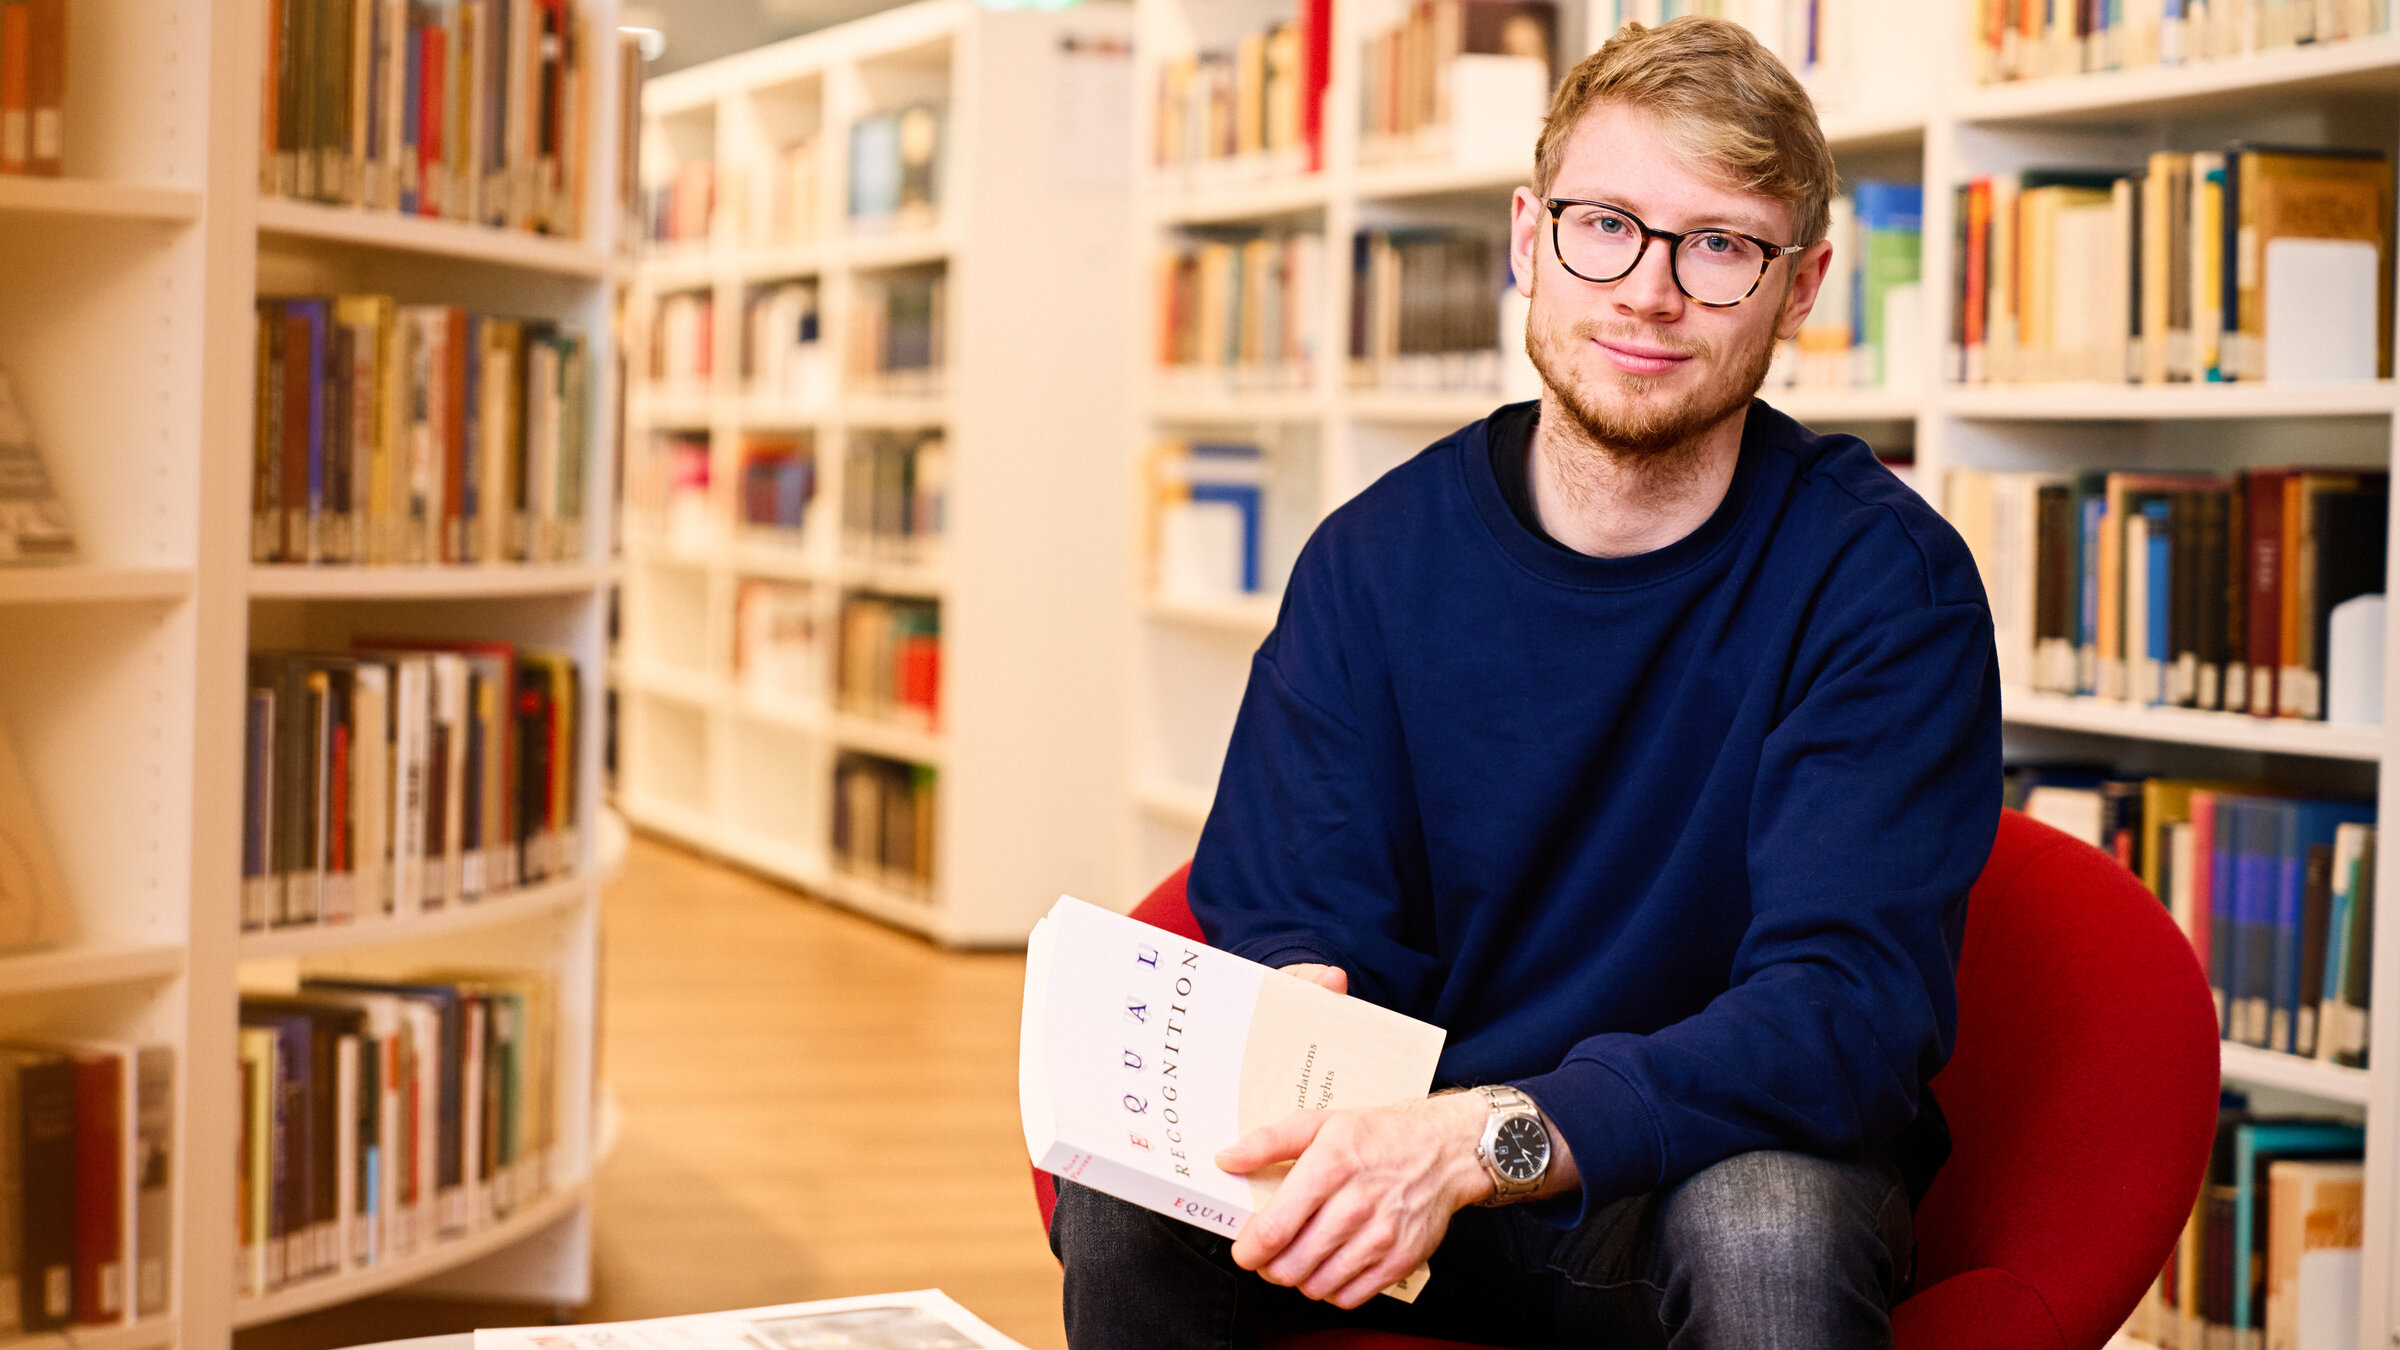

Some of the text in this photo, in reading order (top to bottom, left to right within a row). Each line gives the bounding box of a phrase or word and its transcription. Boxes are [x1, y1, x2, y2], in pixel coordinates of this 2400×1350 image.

[1123, 949, 1159, 1151] EQUAL
[1162, 948, 1200, 1178] RECOGNITION
[1173, 1197, 1237, 1228] EQUAL
